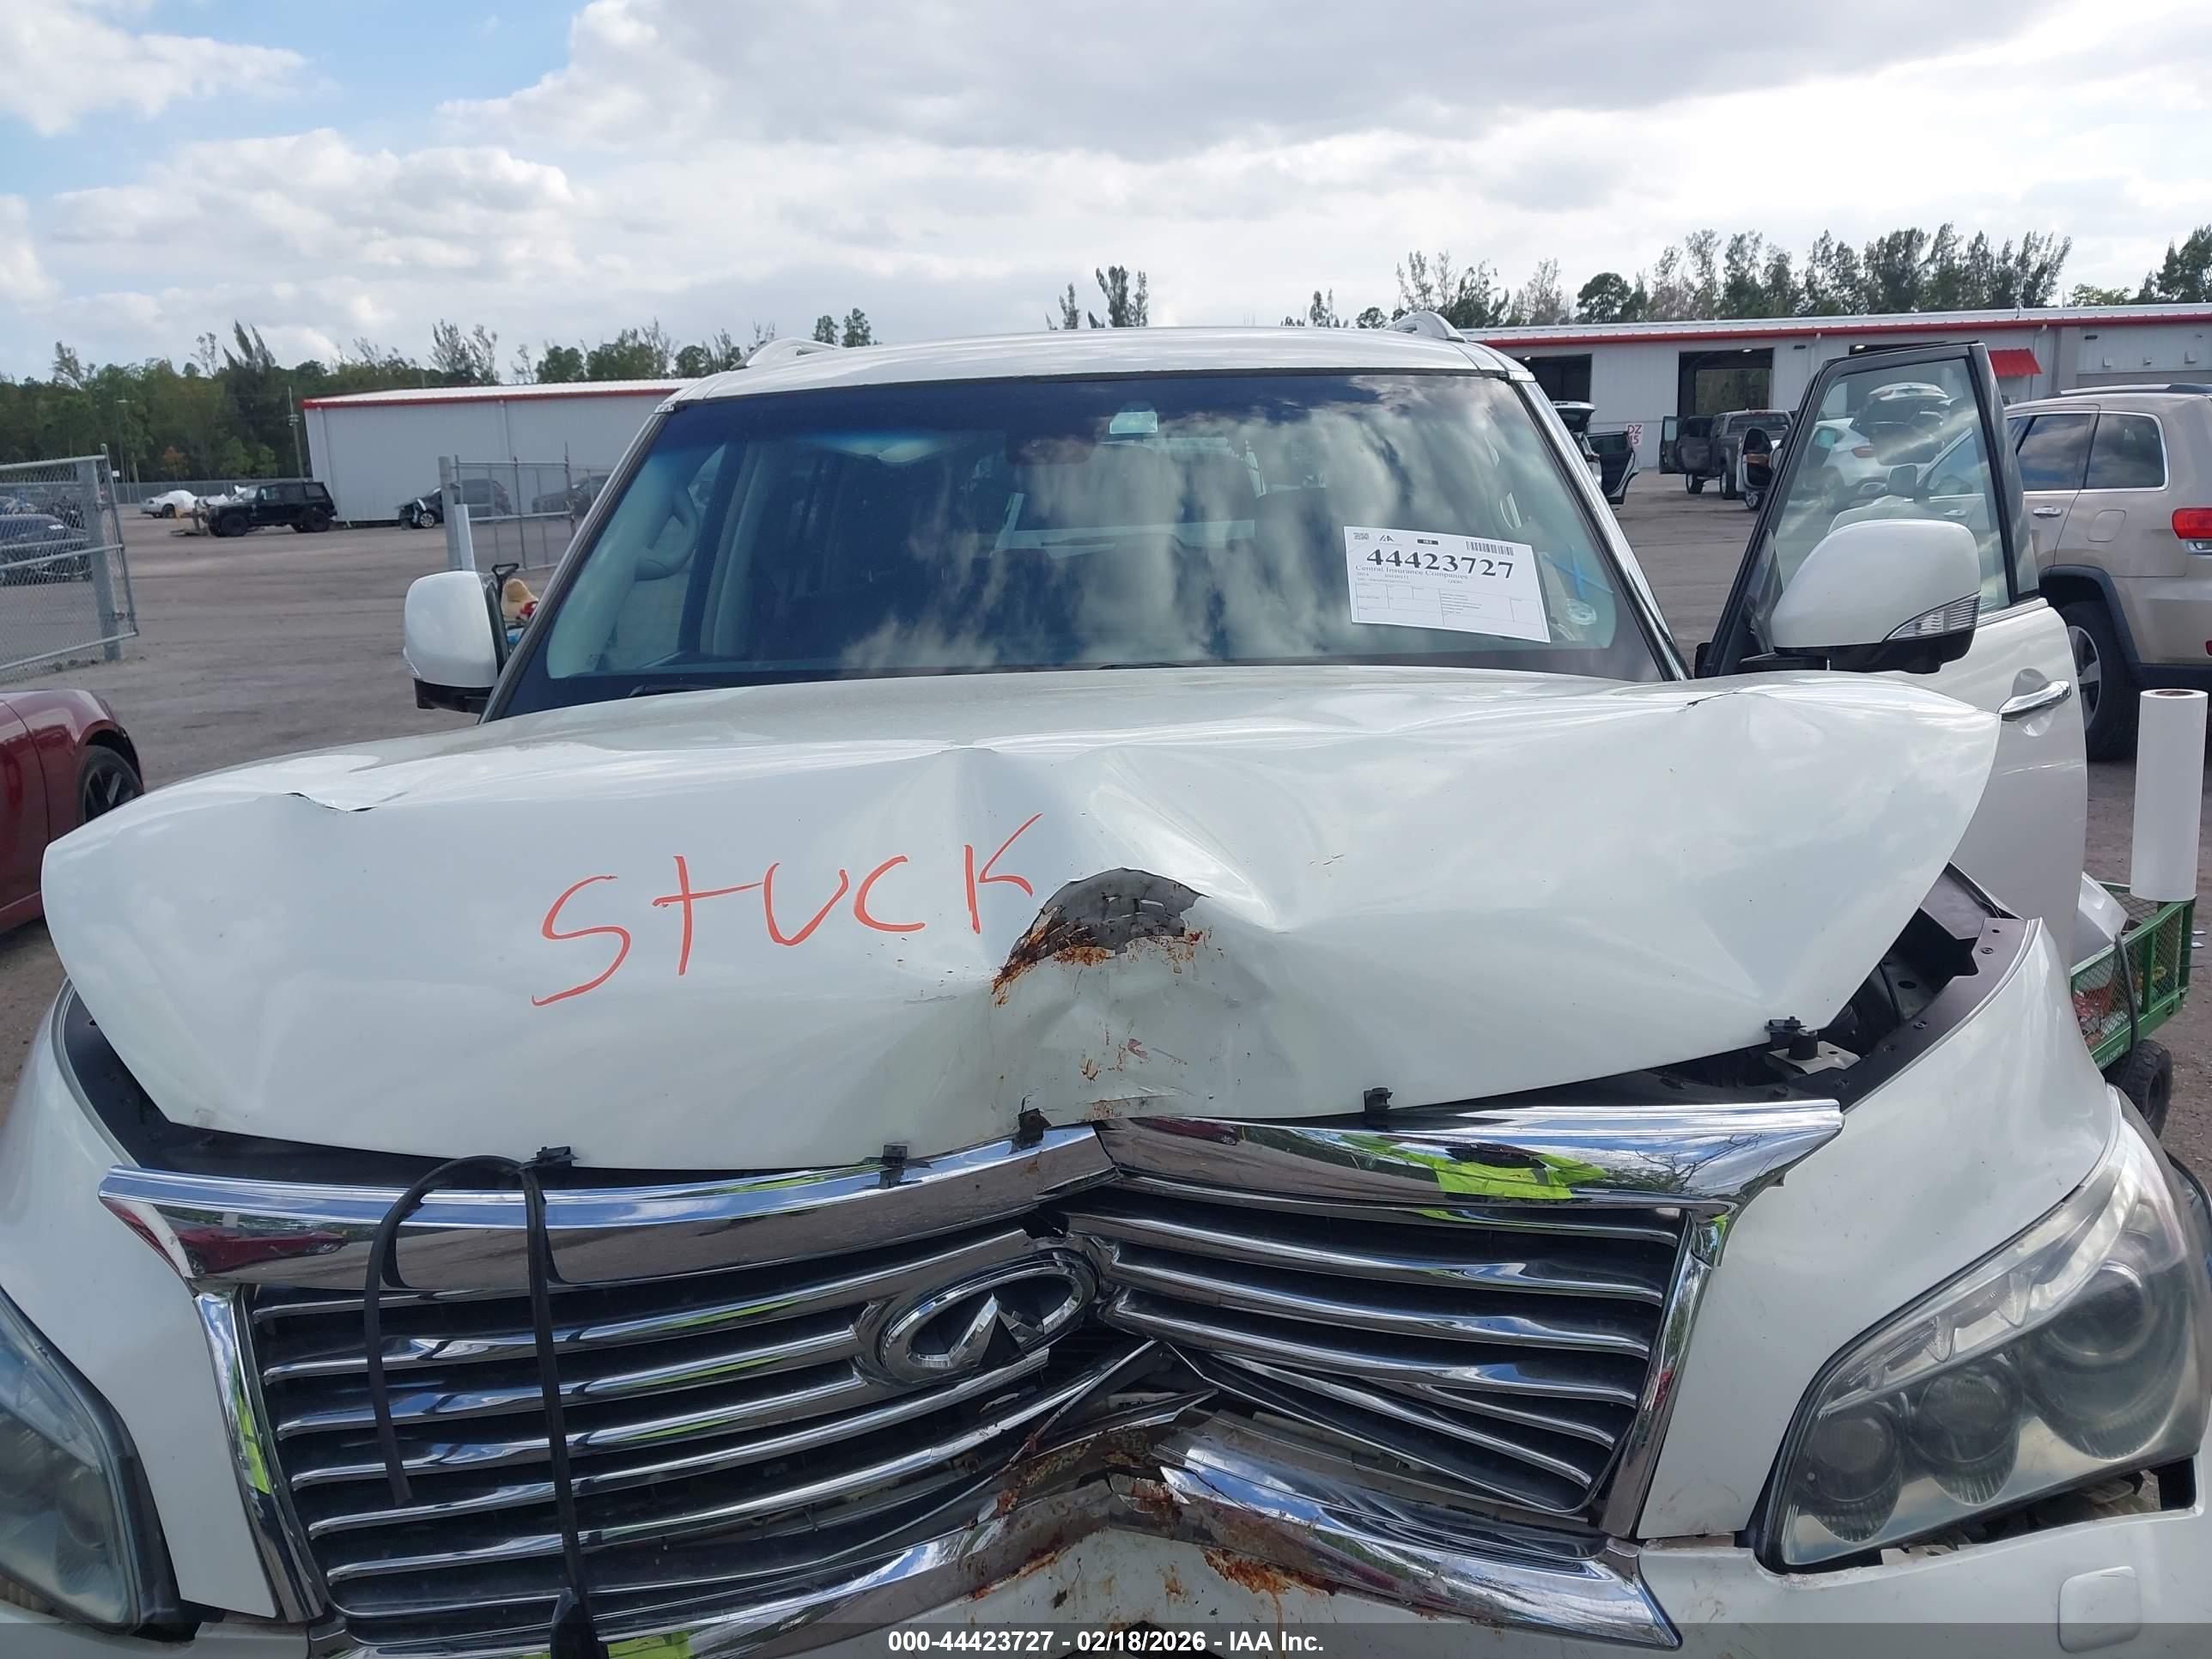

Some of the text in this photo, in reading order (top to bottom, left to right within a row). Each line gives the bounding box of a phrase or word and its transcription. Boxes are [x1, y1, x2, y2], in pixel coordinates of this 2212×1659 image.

[1366, 549, 1514, 579] 44423727
[1386, 567, 1424, 575] Insurance
[1425, 569, 1468, 580] Companies
